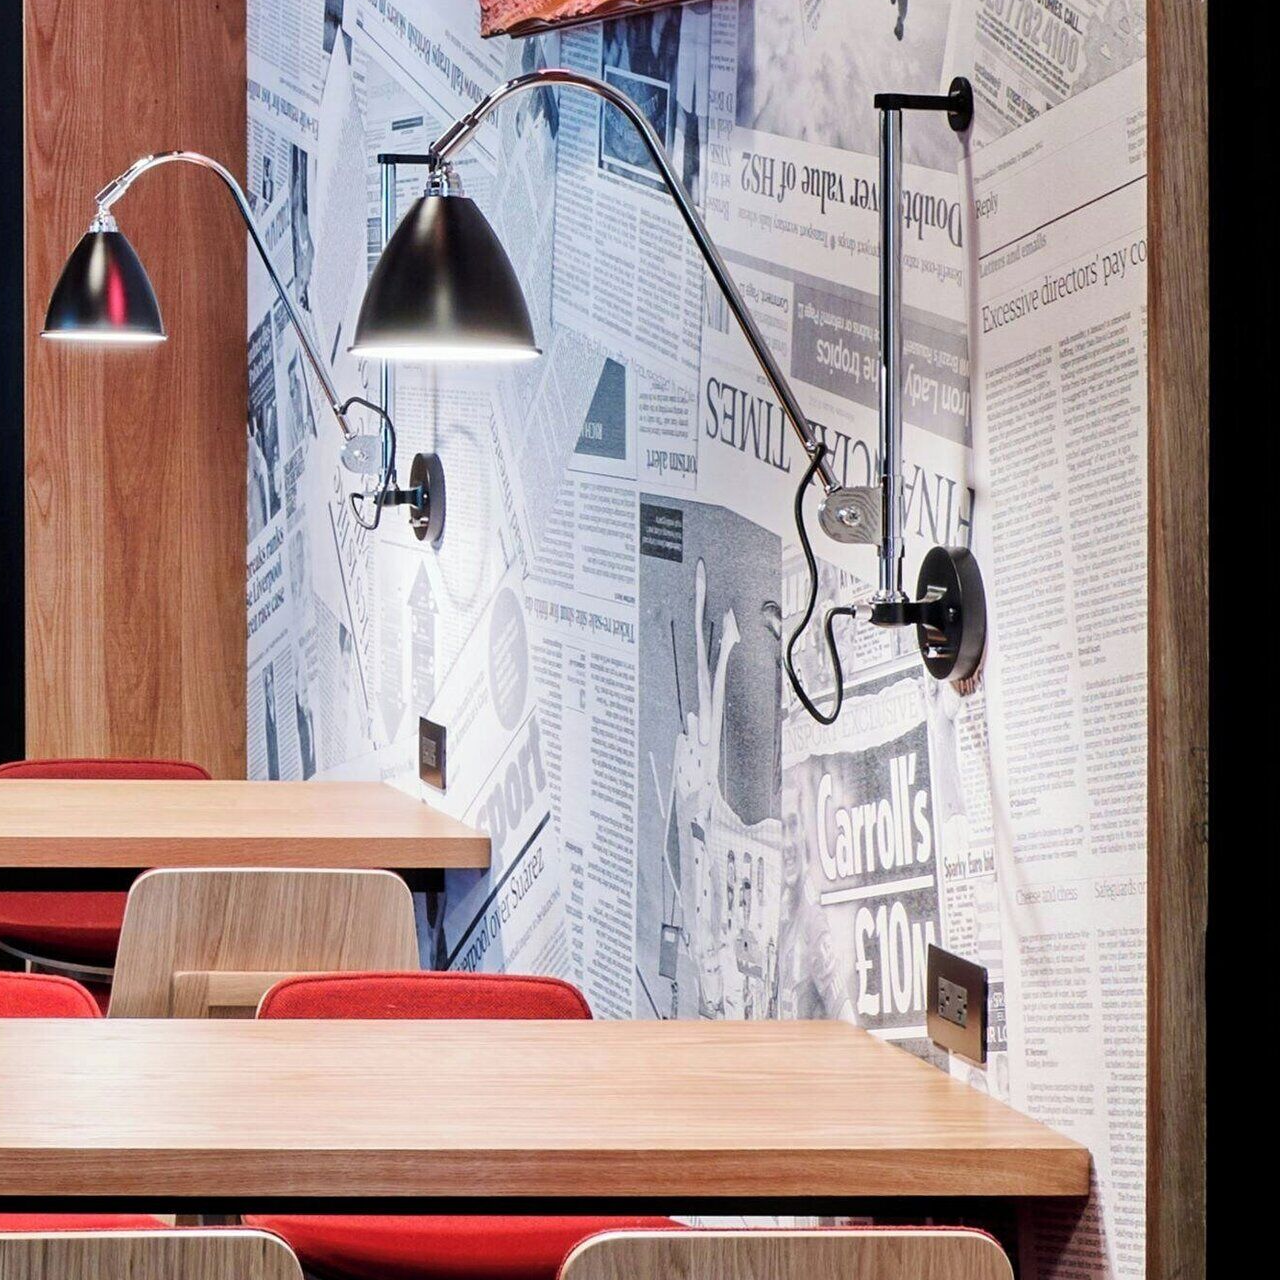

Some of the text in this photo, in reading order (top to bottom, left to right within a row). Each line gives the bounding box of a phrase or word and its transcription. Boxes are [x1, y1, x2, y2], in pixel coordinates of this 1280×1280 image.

[407, 20, 432, 65] British
[431, 43, 451, 81] traps
[1041, 16, 1079, 73] 4100
[741, 151, 776, 199] HS2
[777, 160, 797, 204] of
[801, 165, 845, 215] value
[974, 191, 999, 221] Reply
[803, 224, 829, 249] Transport
[837, 232, 856, 255] drops
[1006, 242, 1021, 266] and
[1021, 231, 1048, 259] emails
[920, 257, 963, 288] Benefit-cost
[981, 286, 1039, 334] Excessive
[1041, 253, 1100, 307] directors'
[1102, 244, 1128, 287] pay
[816, 338, 861, 387] tropics
[904, 363, 938, 415] Lady
[705, 376, 792, 474] TIMES
[646, 448, 669, 476] alert
[252, 551, 282, 602] Liverpool
[612, 618, 636, 644] Ticket
[842, 691, 920, 738] EXCLUSIVE
[817, 752, 932, 882] Carroll's
[944, 856, 967, 879] Sparky
[968, 852, 984, 874] Euro
[1042, 885, 1056, 903] and
[1057, 887, 1079, 902] chess
[1094, 877, 1137, 902] Safeguards
[490, 893, 511, 940] over
